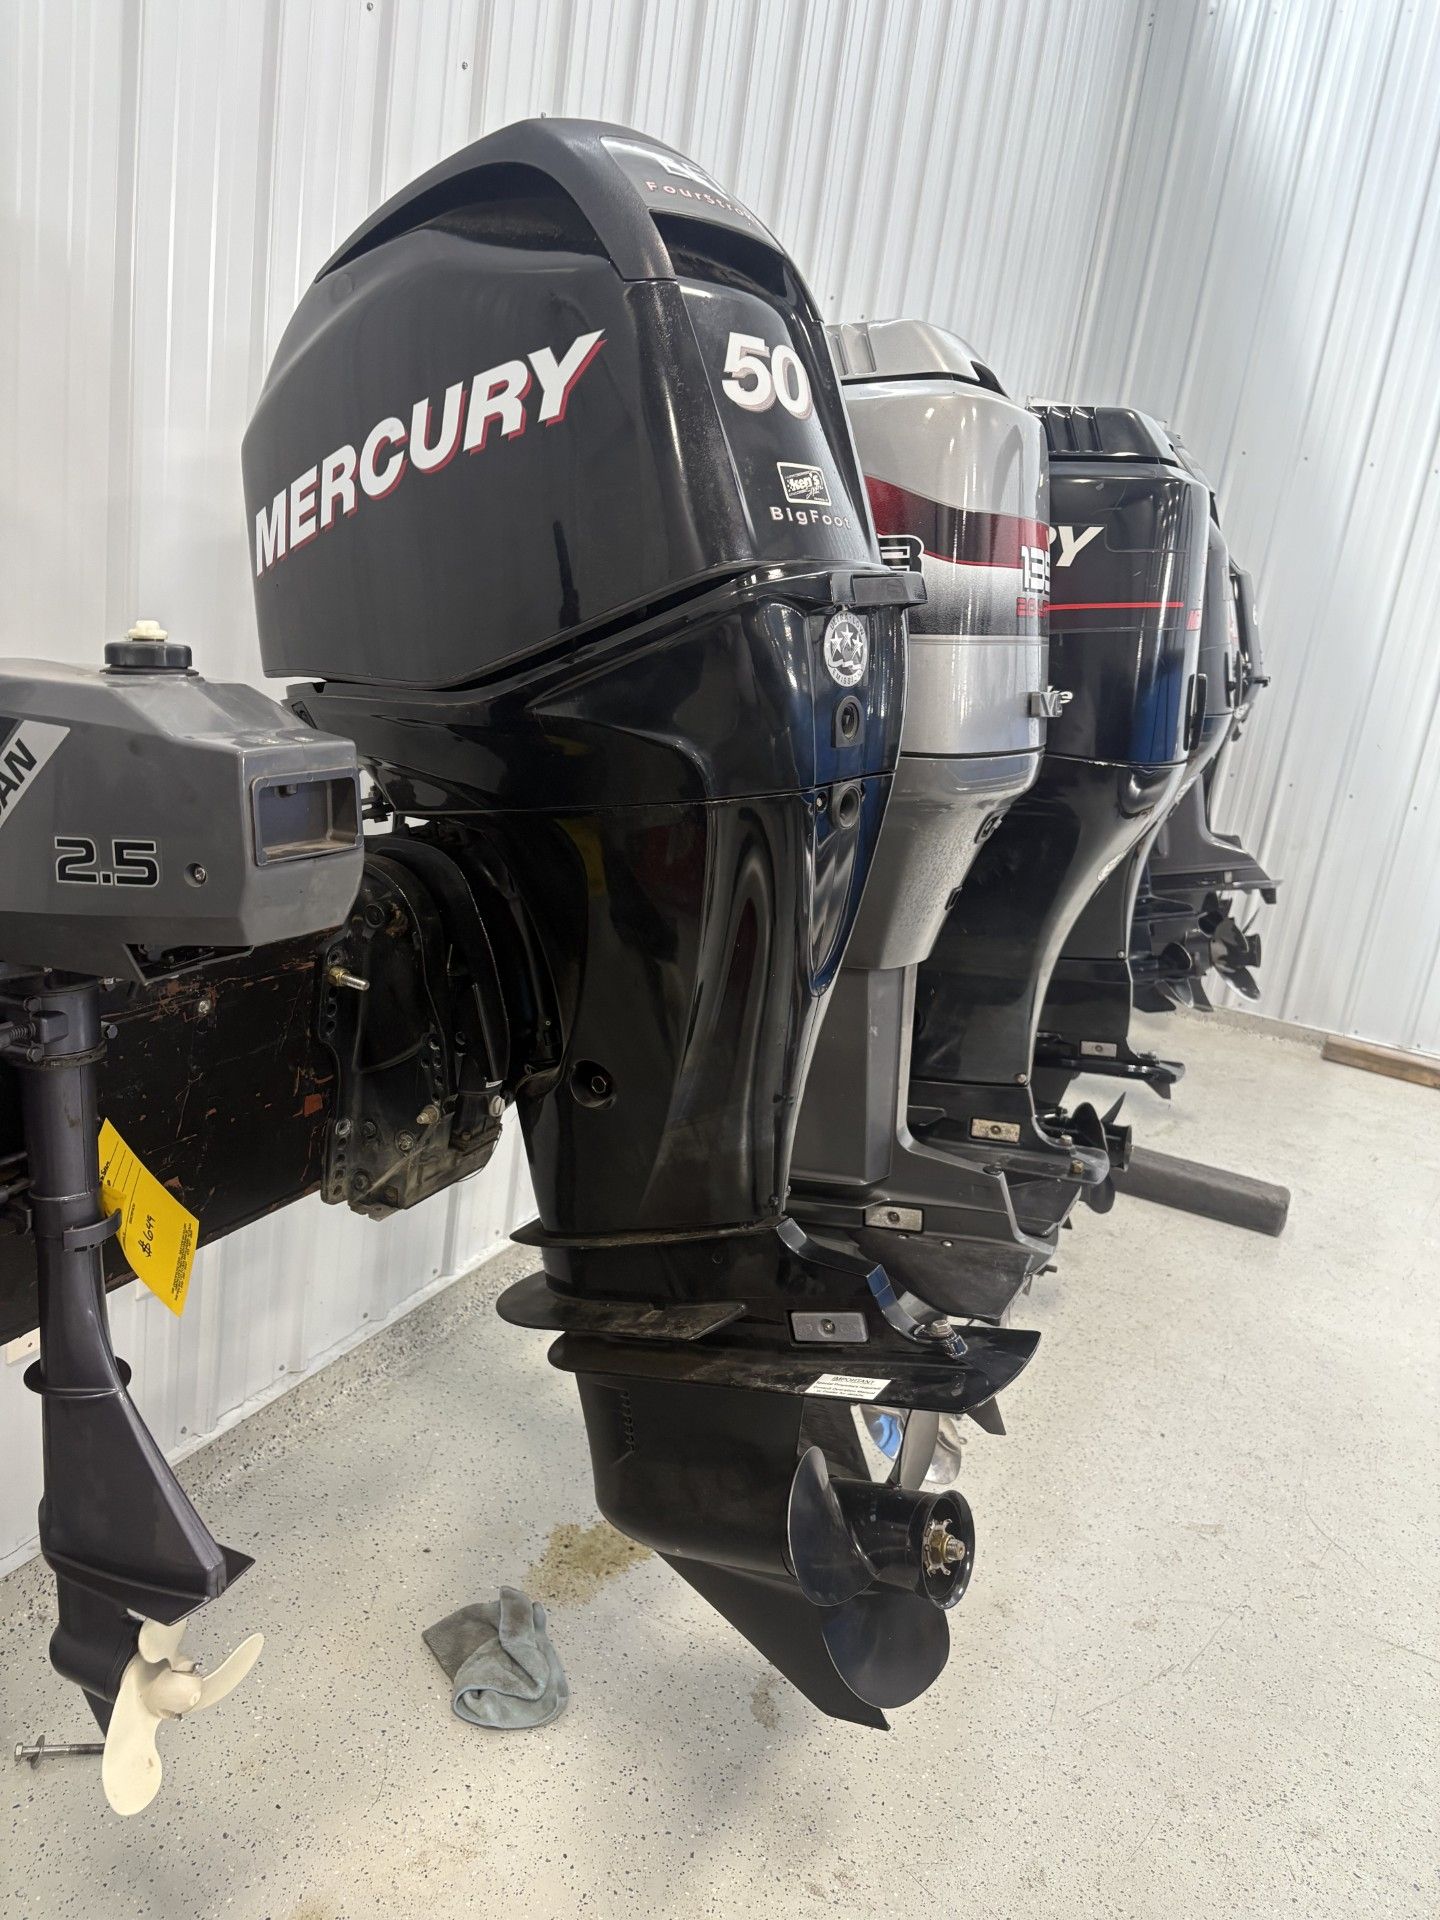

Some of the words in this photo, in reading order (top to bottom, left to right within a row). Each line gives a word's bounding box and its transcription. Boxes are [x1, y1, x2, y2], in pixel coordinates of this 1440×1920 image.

[721, 332, 812, 419] 50
[255, 328, 606, 580] MERCURY
[769, 506, 852, 530] BigFoot
[0, 737, 38, 811] AN
[54, 836, 160, 888] 2.5
